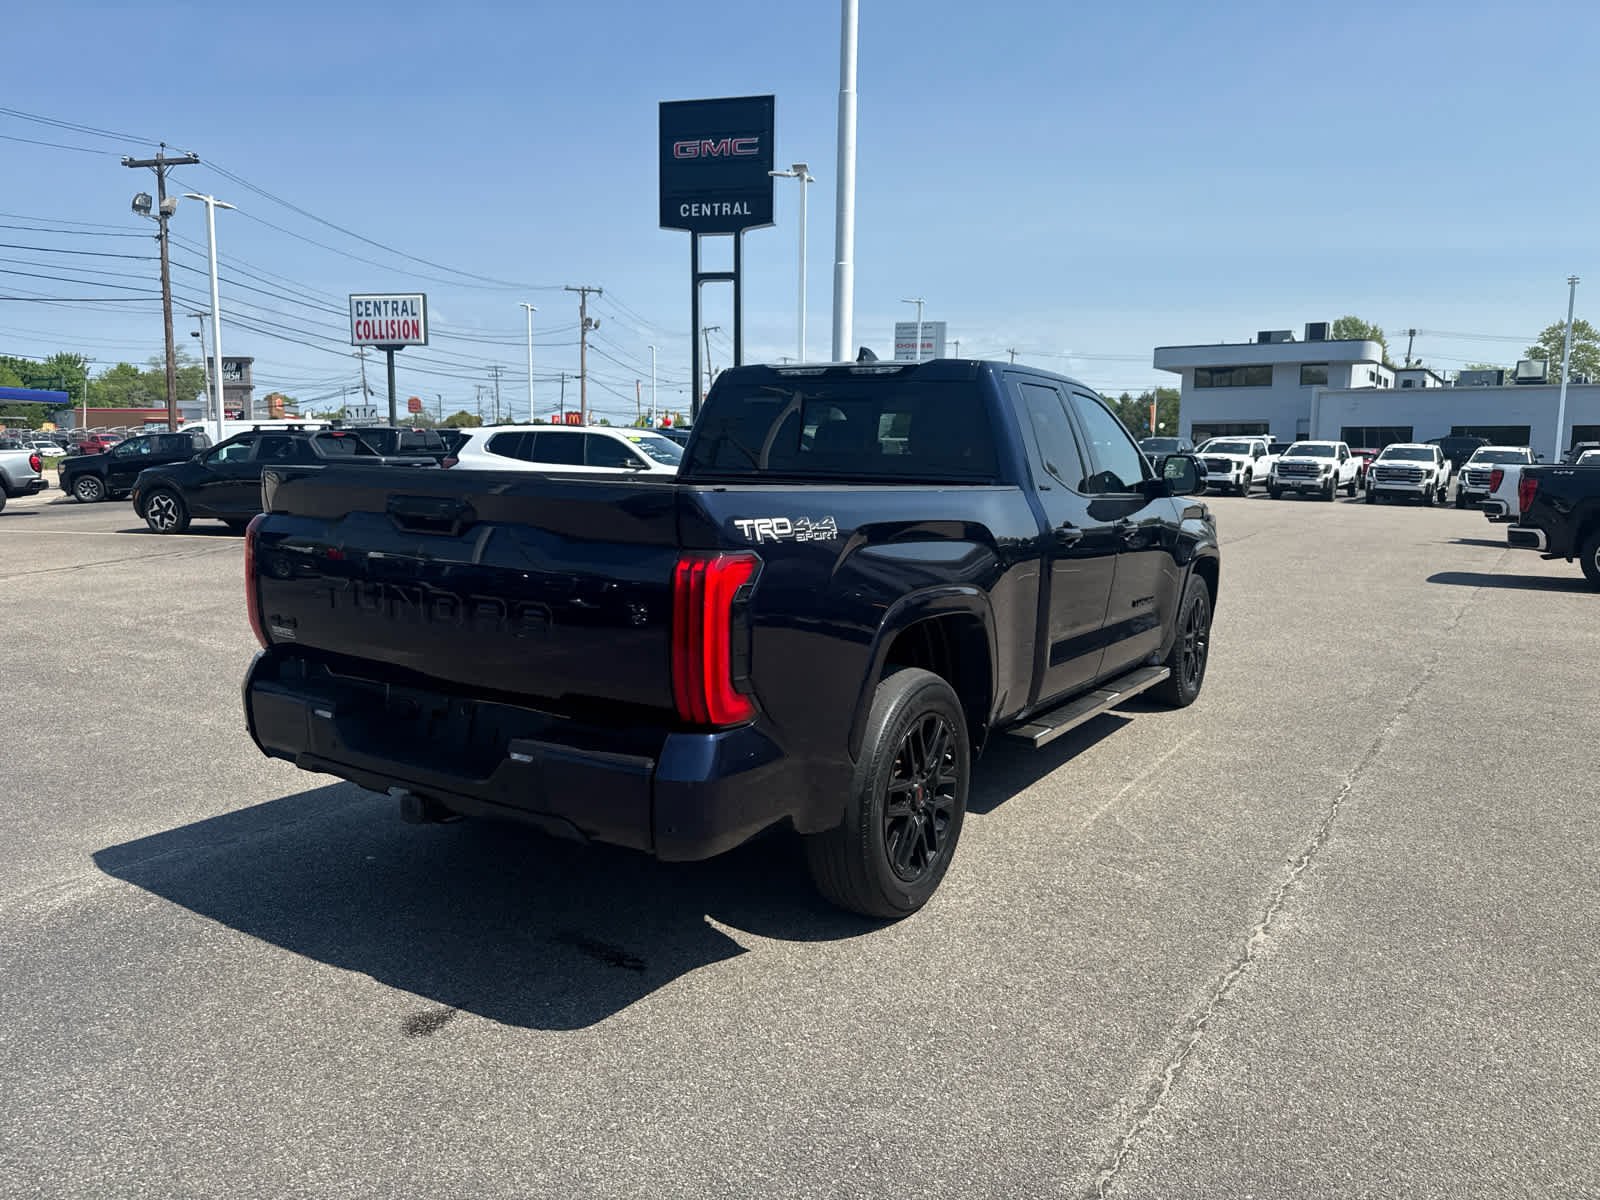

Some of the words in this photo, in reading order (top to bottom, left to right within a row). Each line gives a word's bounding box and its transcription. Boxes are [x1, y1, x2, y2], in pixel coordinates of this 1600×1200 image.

[673, 137, 759, 159] GMC
[679, 201, 752, 217] CENTRAL
[355, 300, 417, 317] CENTRAL
[355, 319, 420, 340] COLLISION
[733, 517, 796, 545] TRD
[795, 531, 838, 542] SPORT
[318, 575, 554, 639] TUNDRA
